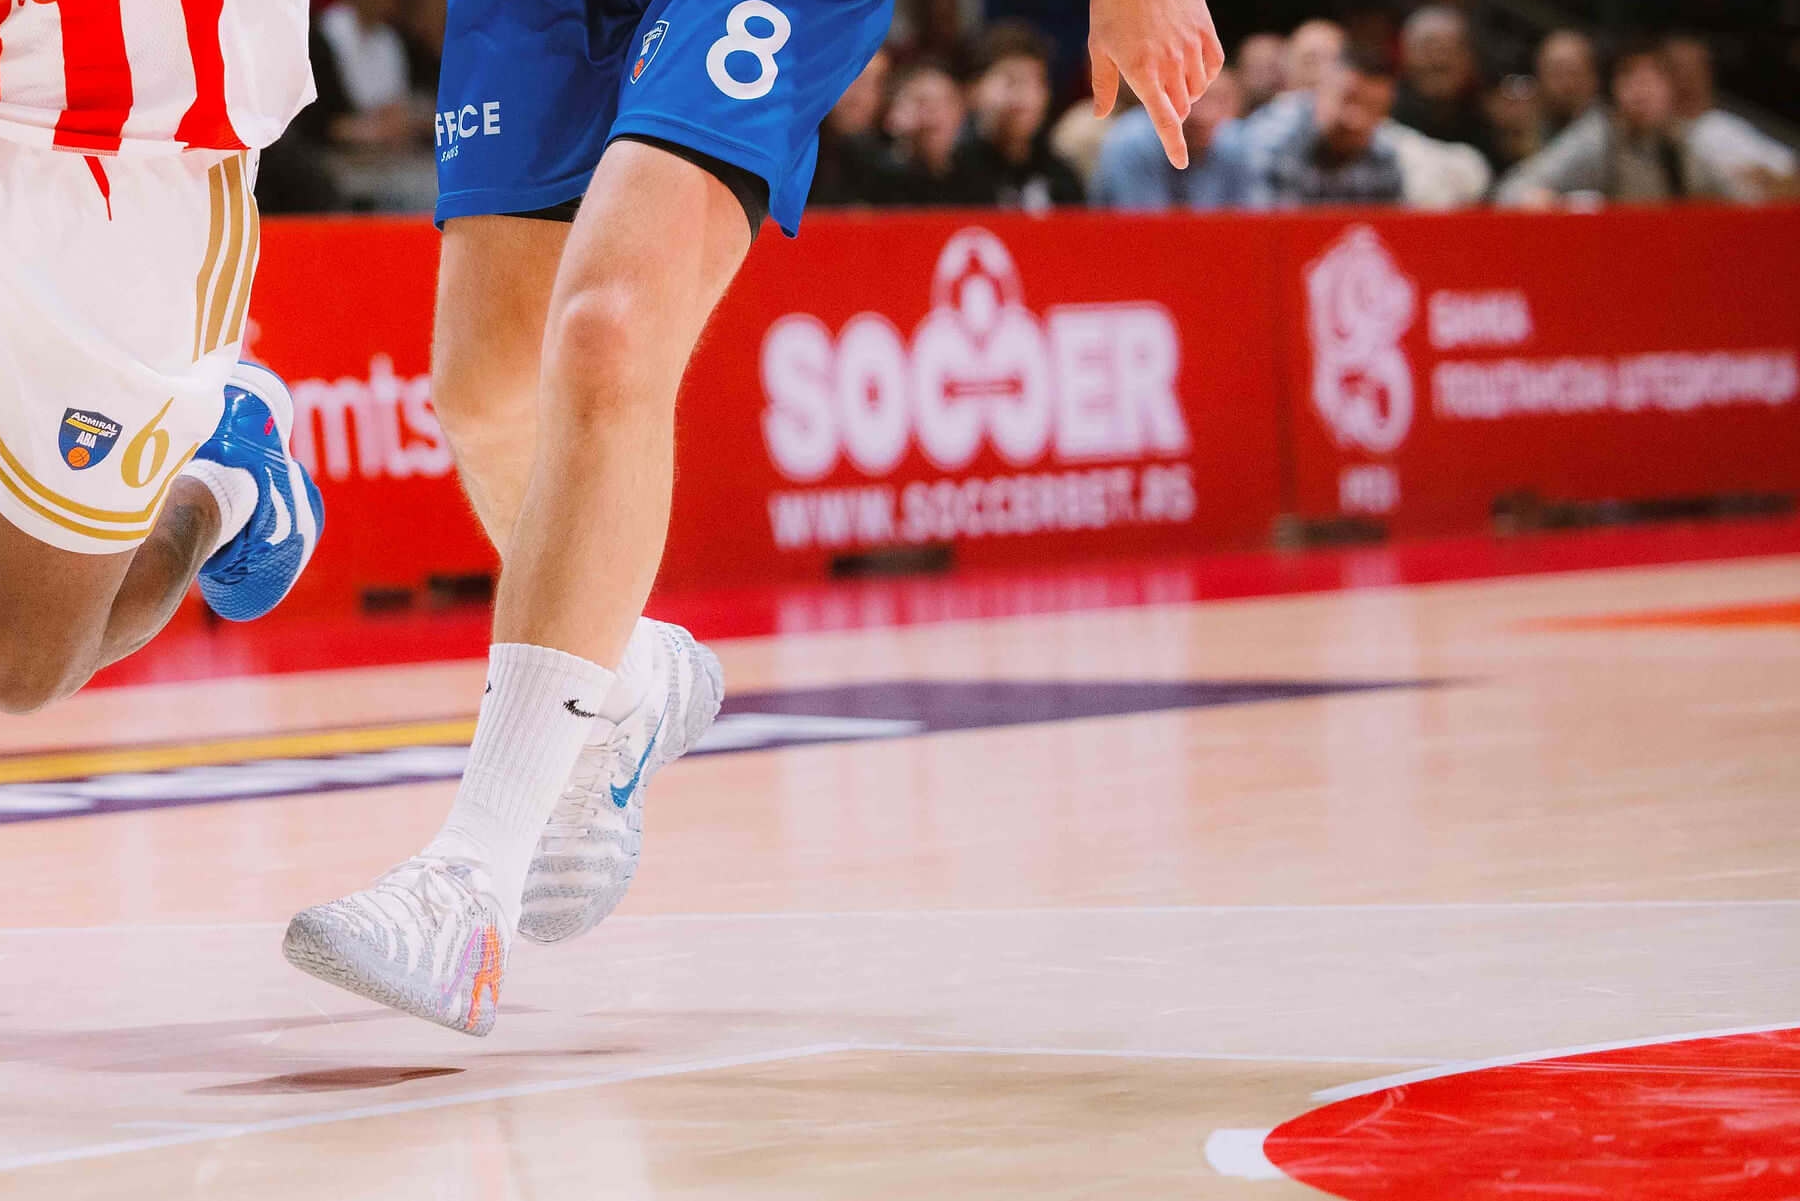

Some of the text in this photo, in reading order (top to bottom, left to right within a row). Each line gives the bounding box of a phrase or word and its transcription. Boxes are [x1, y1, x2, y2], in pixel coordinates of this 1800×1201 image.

[706, 0, 791, 99] 8
[71, 412, 118, 433] ADMIRAL
[761, 302, 1190, 483] SOCCER
[76, 431, 97, 448] ABA
[120, 396, 174, 488] 6
